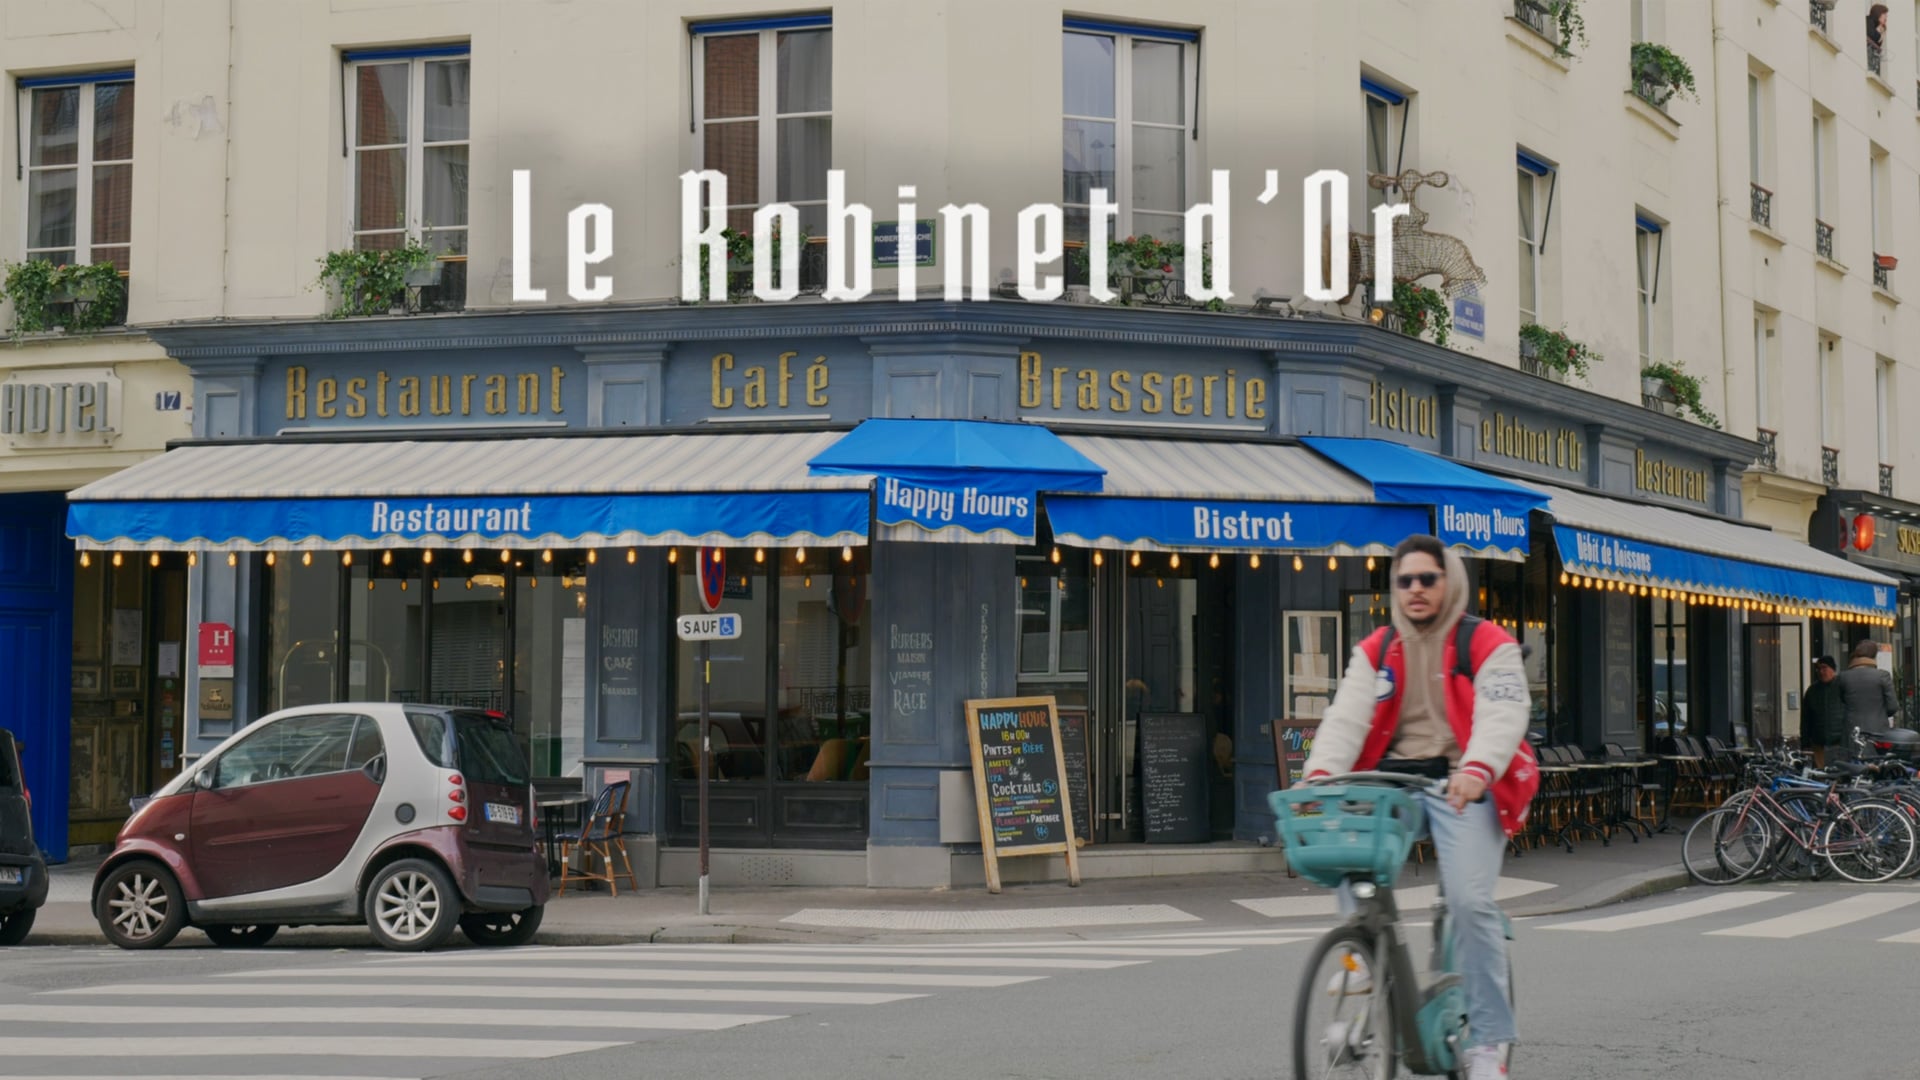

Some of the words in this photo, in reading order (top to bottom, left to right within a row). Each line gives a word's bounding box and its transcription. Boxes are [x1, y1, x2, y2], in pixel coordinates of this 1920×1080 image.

[285, 364, 566, 420] Restaurant
[711, 351, 829, 409] Café
[1019, 351, 1266, 419] Brasserie
[160, 391, 179, 410] 17
[1495, 411, 1551, 466] Robinet
[1556, 427, 1583, 472] d'Or
[1635, 447, 1707, 504] Restaurant
[884, 477, 955, 521] Happy
[962, 486, 1029, 518] Hours
[371, 500, 532, 533] Restaurant
[1193, 505, 1295, 541] Bistrot
[1443, 504, 1491, 542] Happy
[1492, 508, 1526, 537] Hours
[1601, 537, 1613, 566] de
[214, 630, 229, 647] H
[684, 619, 718, 635] SAUF
[891, 623, 933, 649] BURGERS
[893, 688, 928, 716] RACE
[980, 711, 1018, 730] HAPPY
[1018, 710, 1049, 729] HOUR
[983, 743, 1012, 756] PINTES
